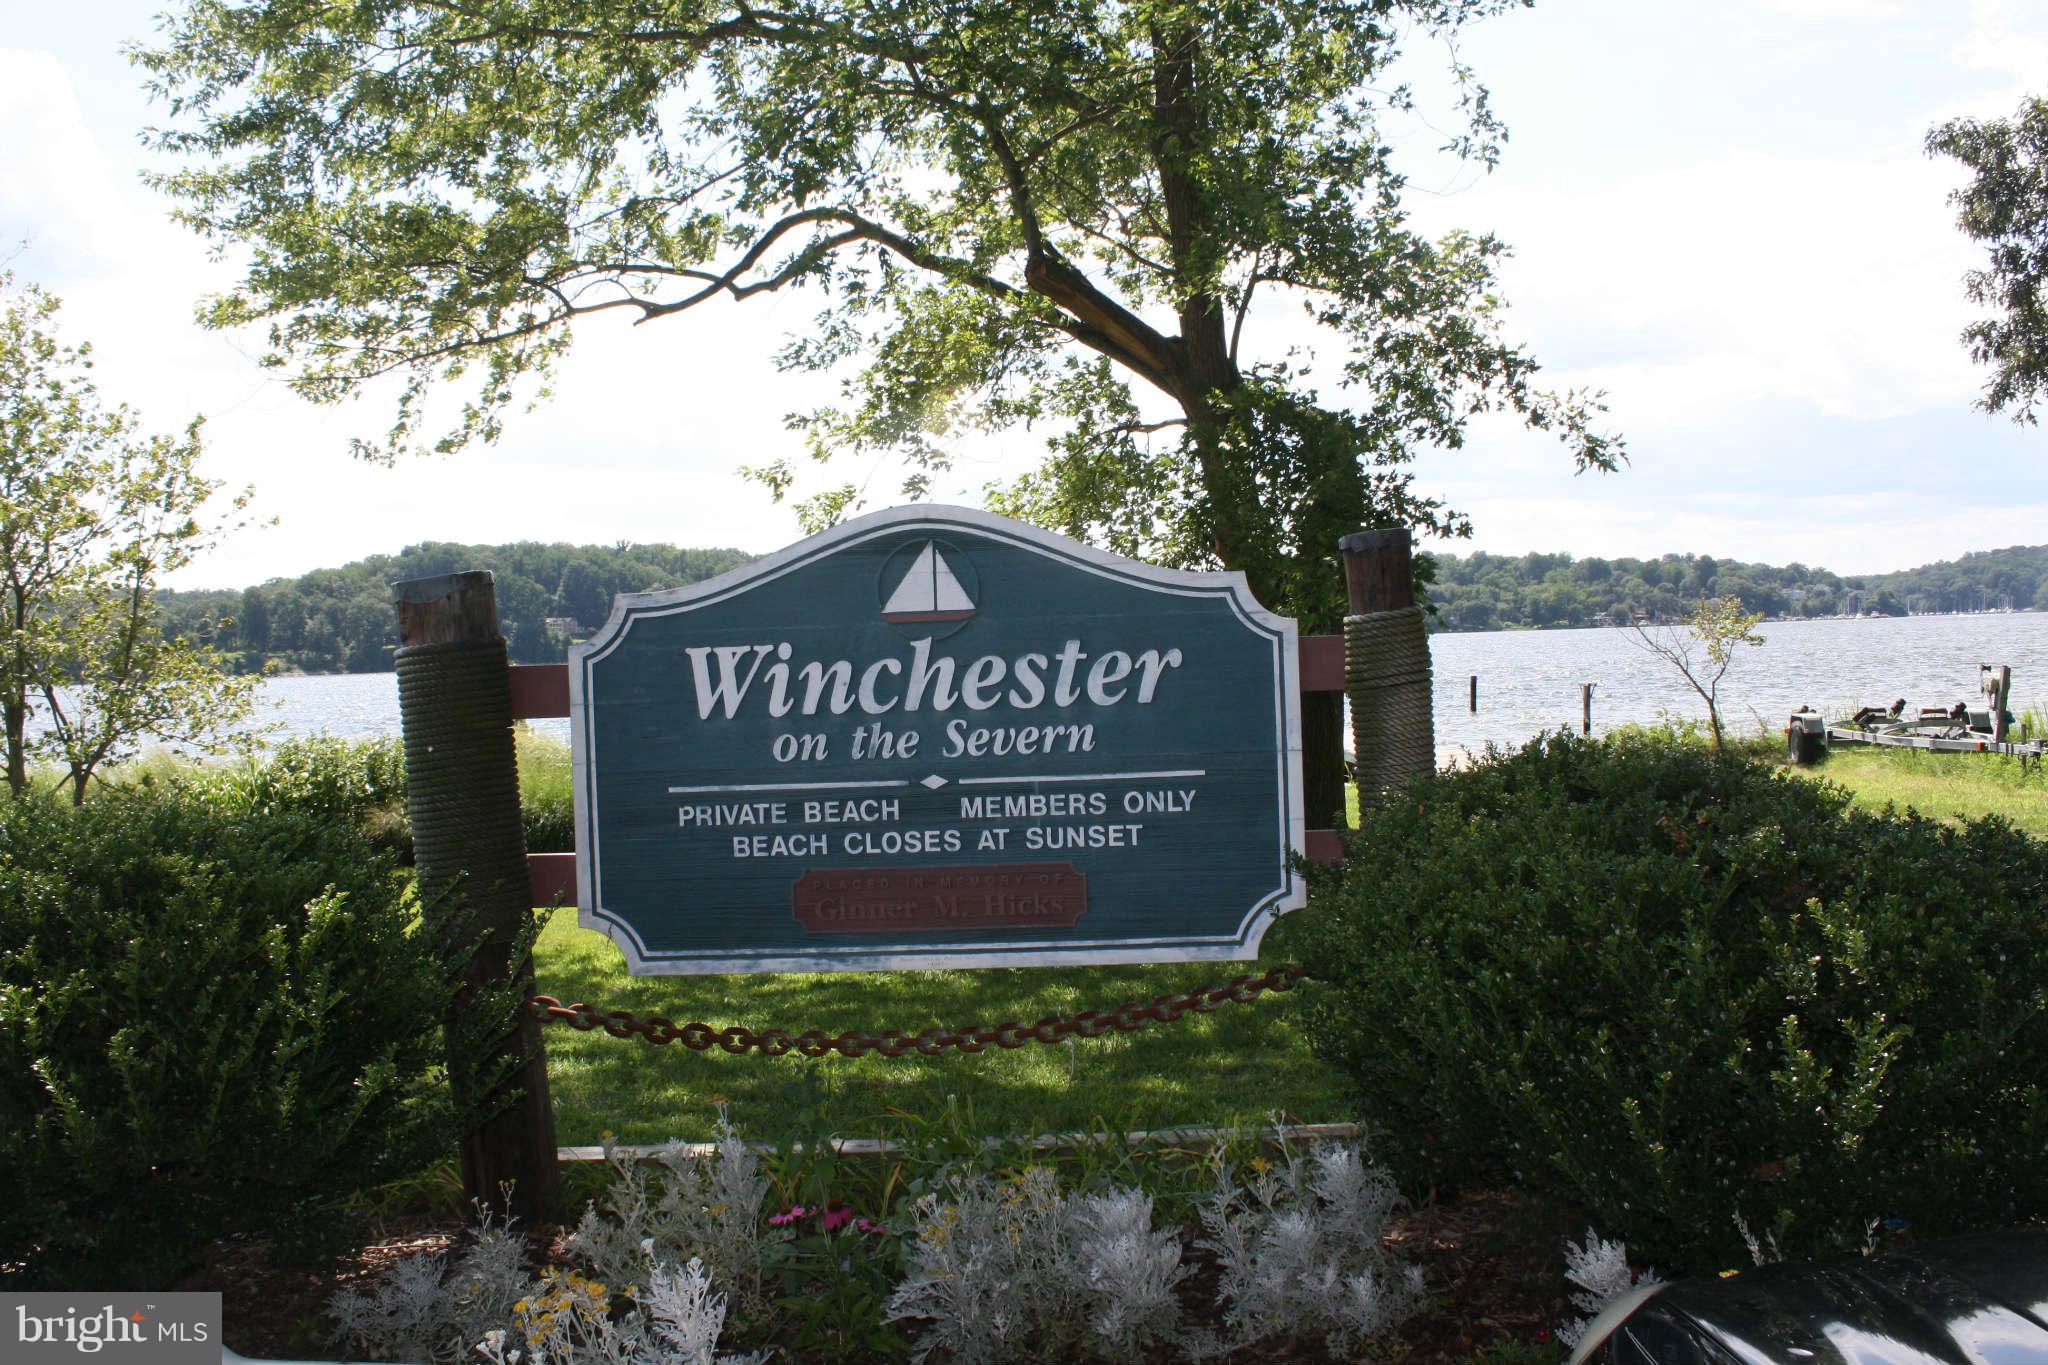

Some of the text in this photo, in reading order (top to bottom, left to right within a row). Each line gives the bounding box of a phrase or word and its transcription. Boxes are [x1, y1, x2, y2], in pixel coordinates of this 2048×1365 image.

[684, 636, 1183, 721] Winchester
[772, 719, 1097, 763] on the Severn
[678, 789, 1197, 828] PRIVATE BEACH MEMBERS ONLY
[732, 824, 1144, 859] BEACH CLOSES AT SUNSET
[813, 873, 1064, 891] PLACED IN MEMORY OF
[932, 895, 970, 918] M.
[983, 892, 1065, 917] Hicks
